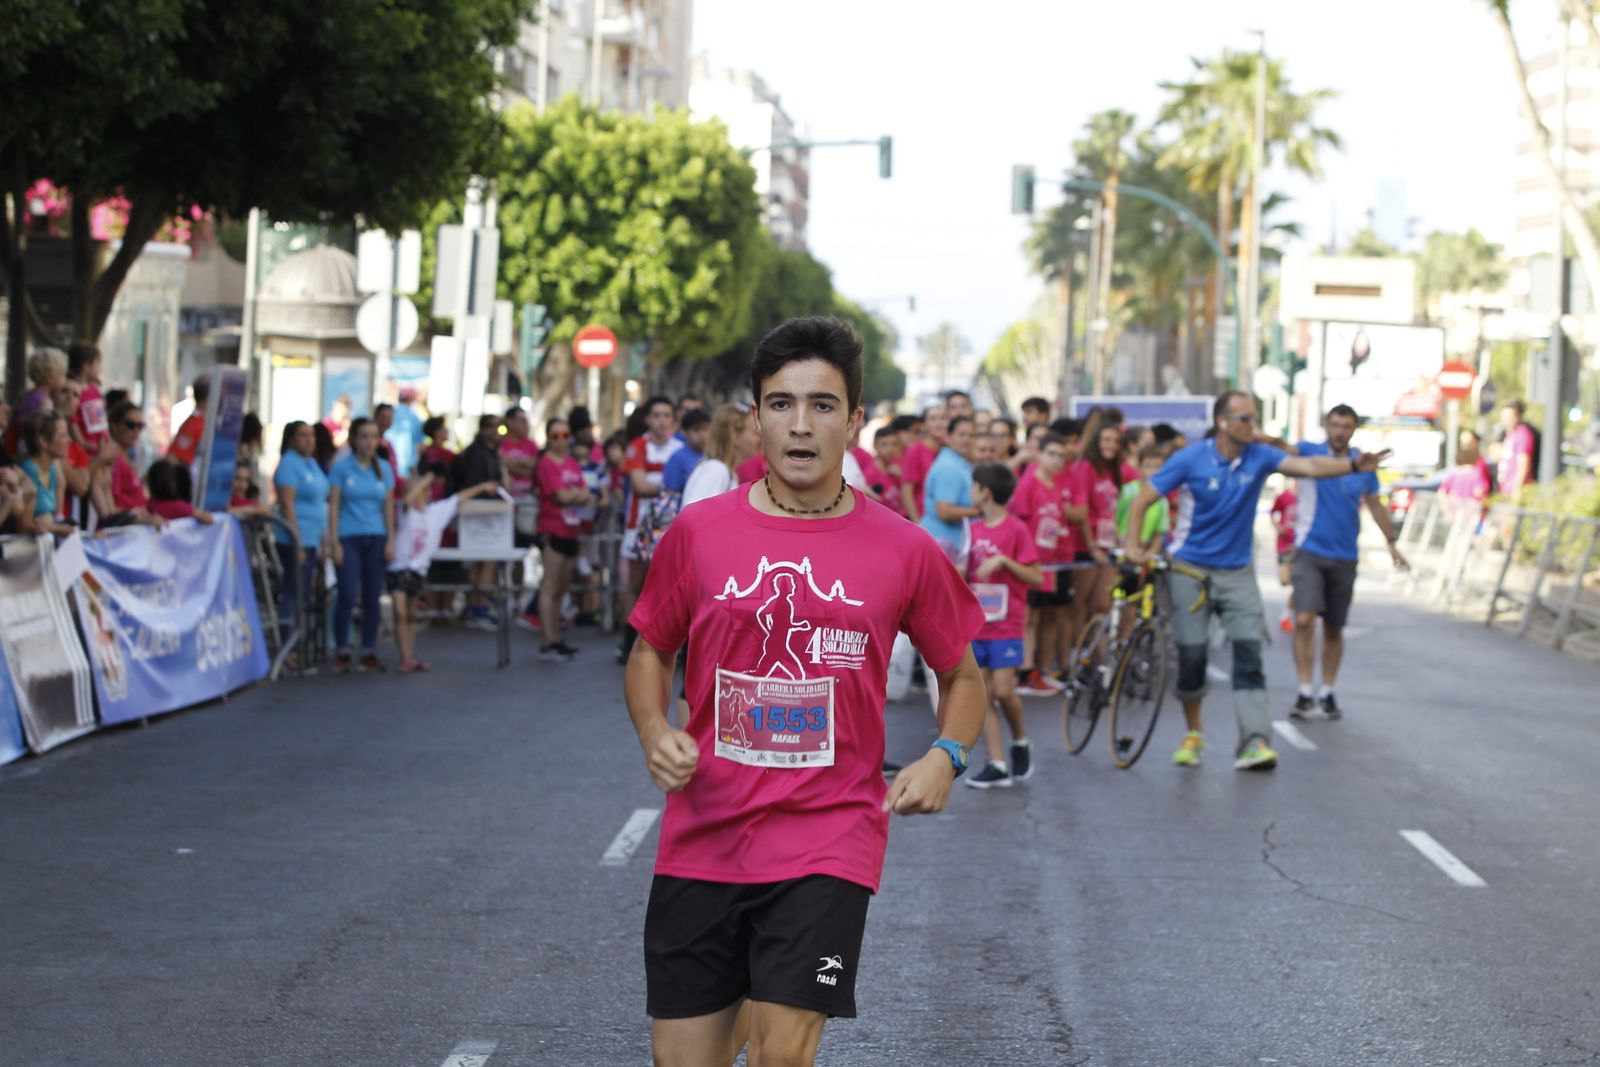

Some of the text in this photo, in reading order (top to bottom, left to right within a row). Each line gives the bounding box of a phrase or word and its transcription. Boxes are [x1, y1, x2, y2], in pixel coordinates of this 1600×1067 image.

[804, 627, 869, 664] 4 CARRERA
[761, 683, 794, 694] CARRERA
[749, 706, 827, 733] 1553
[771, 733, 800, 744] RAFAEL
